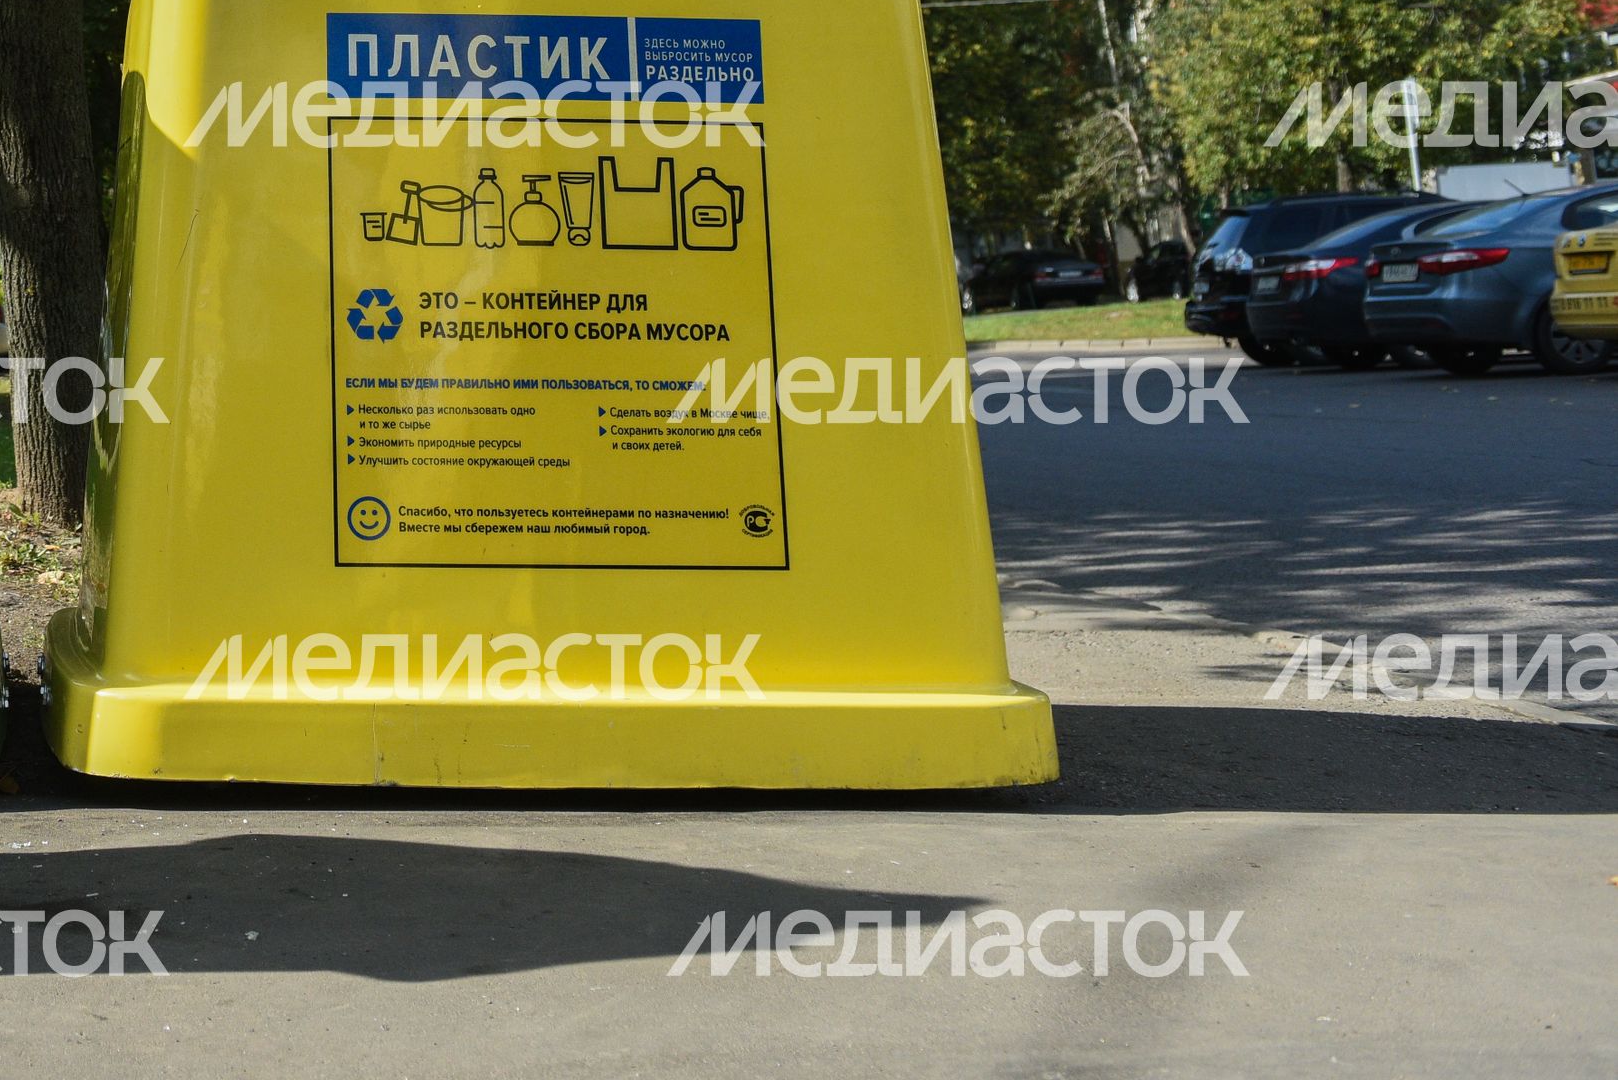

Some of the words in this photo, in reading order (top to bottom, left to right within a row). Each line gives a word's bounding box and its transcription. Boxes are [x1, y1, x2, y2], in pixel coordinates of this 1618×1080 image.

[645, 38, 678, 49] ЗДЕСЬ
[683, 39, 725, 49] МОЖНО
[347, 33, 611, 81] ПЛАСТИК
[645, 51, 711, 62] ВЫБРОСИТЬ
[715, 53, 753, 63] МУСОР
[646, 65, 754, 83] РАЗДЕЛЬНО
[419, 292, 459, 311] ЭТО
[482, 289, 601, 311] КОНТЕЙНЕР
[606, 294, 648, 315] ДЛЯ
[420, 321, 568, 341] РАЗДЕЛЬНОГО
[575, 322, 641, 341] СБОРА
[647, 323, 730, 342] МУСОРА
[346, 378, 375, 388] ЕСЛИ
[378, 378, 397, 388] МЫ
[401, 378, 438, 390] БУДЕМ
[442, 378, 510, 389] ПРАВИЛЬНО
[513, 379, 538, 389] ИМИ
[542, 379, 633, 391] ПОЛЬЗОВАТЬСЯ,
[636, 381, 650, 390] ТО
[653, 381, 706, 391] СМОЖЕМ:
[358, 404, 413, 415] Несколько
[417, 407, 434, 416] раз
[438, 406, 507, 415] использовать
[510, 407, 535, 416] одно
[610, 408, 651, 419] Сделать
[654, 409, 688, 420] воздух
[692, 410, 697, 418] в
[700, 408, 738, 419] Москве
[741, 410, 770, 421] чище,
[360, 421, 365, 429] и
[369, 421, 379, 429] то
[382, 421, 396, 429] же
[399, 421, 431, 431] сырье
[611, 426, 663, 437] Сохранить
[666, 427, 714, 437] экологию
[718, 428, 735, 438] для
[738, 427, 761, 437] себя
[359, 437, 414, 448] Экономить
[418, 439, 475, 450] природные
[478, 439, 521, 450] ресурсы
[613, 442, 618, 450] и
[621, 442, 650, 450] своих
[653, 441, 685, 451] детей.
[359, 455, 409, 466] Улучшить
[412, 457, 464, 466] состояние
[467, 457, 535, 468] окружающей
[538, 458, 570, 467] среды
[399, 506, 451, 520] Спасибо,
[454, 509, 473, 517] что
[476, 508, 549, 520] пользуетесь
[552, 507, 634, 520] контейнерами
[638, 509, 651, 518] по
[655, 508, 729, 519] назначению!
[399, 522, 440, 532] Вместе
[443, 524, 462, 532] мы
[465, 523, 523, 535] сбережем
[527, 525, 550, 533] наш
[554, 522, 610, 534] любимый
[613, 525, 651, 536] город.
